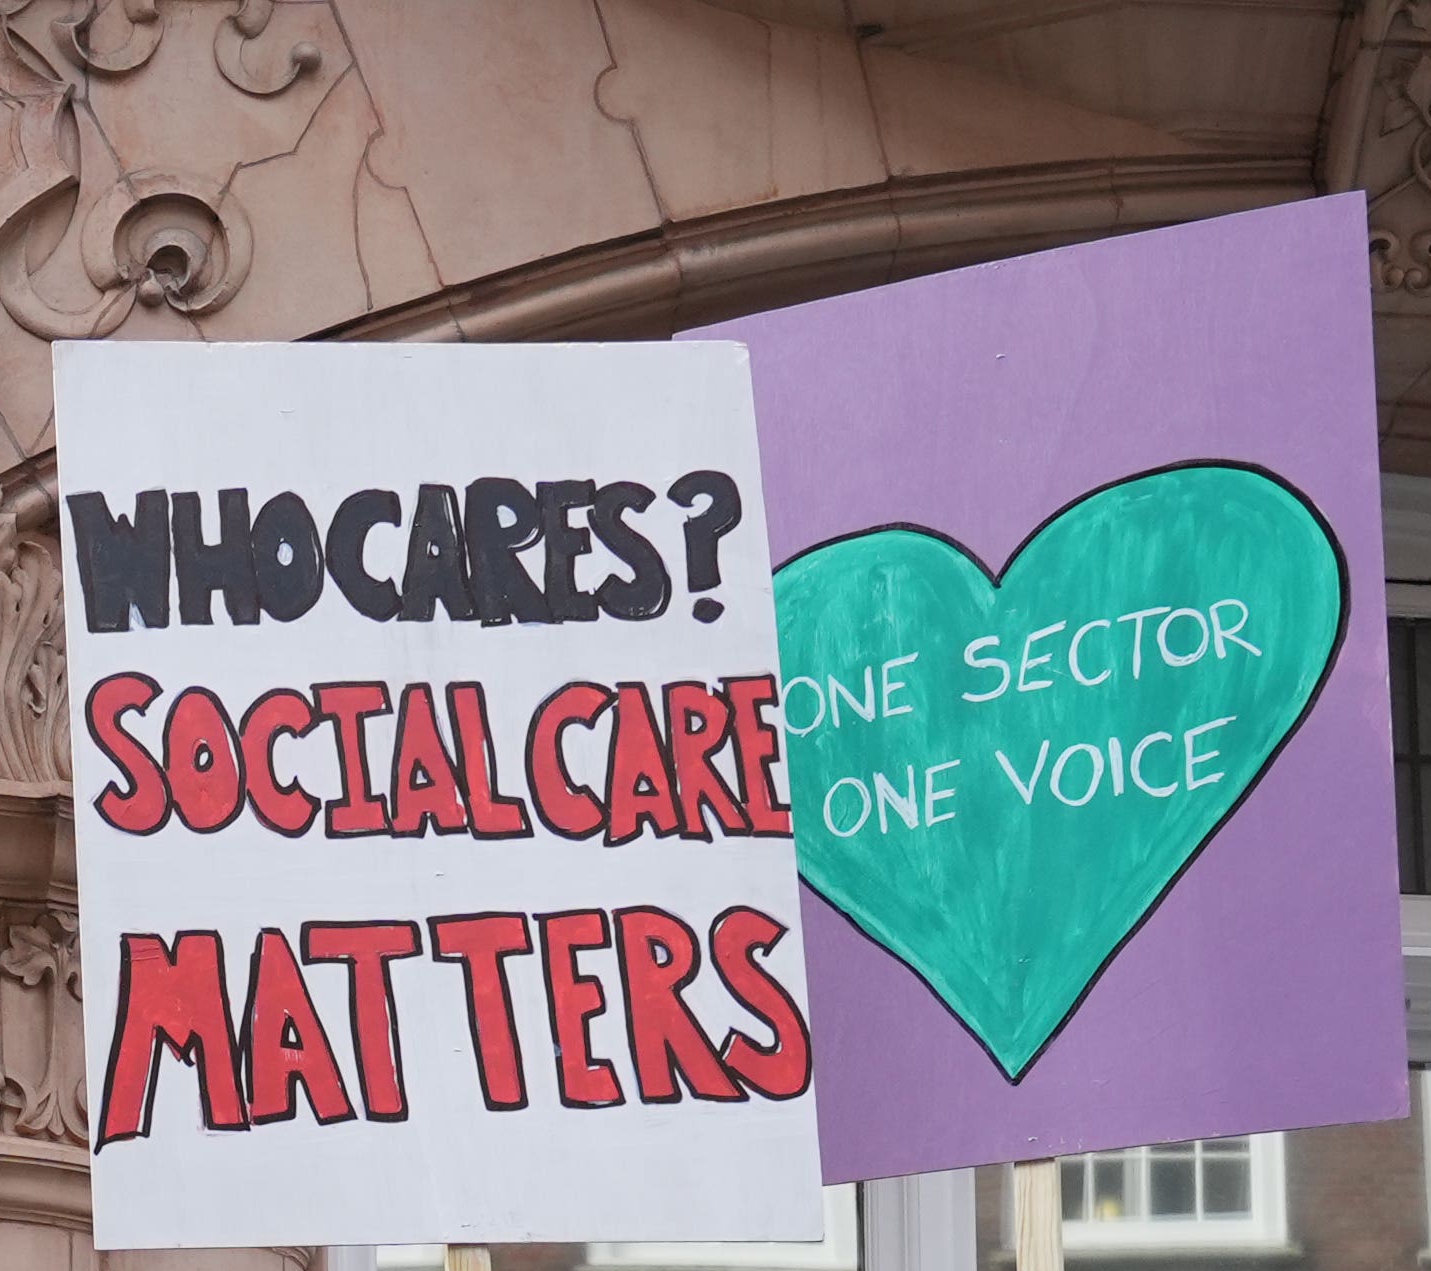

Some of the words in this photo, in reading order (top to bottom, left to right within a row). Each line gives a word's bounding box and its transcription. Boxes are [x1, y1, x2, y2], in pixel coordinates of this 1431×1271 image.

[779, 652, 919, 738] ONE
[962, 599, 1262, 703] SECTOR
[823, 760, 961, 837] ONE
[995, 716, 1237, 806] VOICE
[95, 904, 814, 1155] MATTERS
